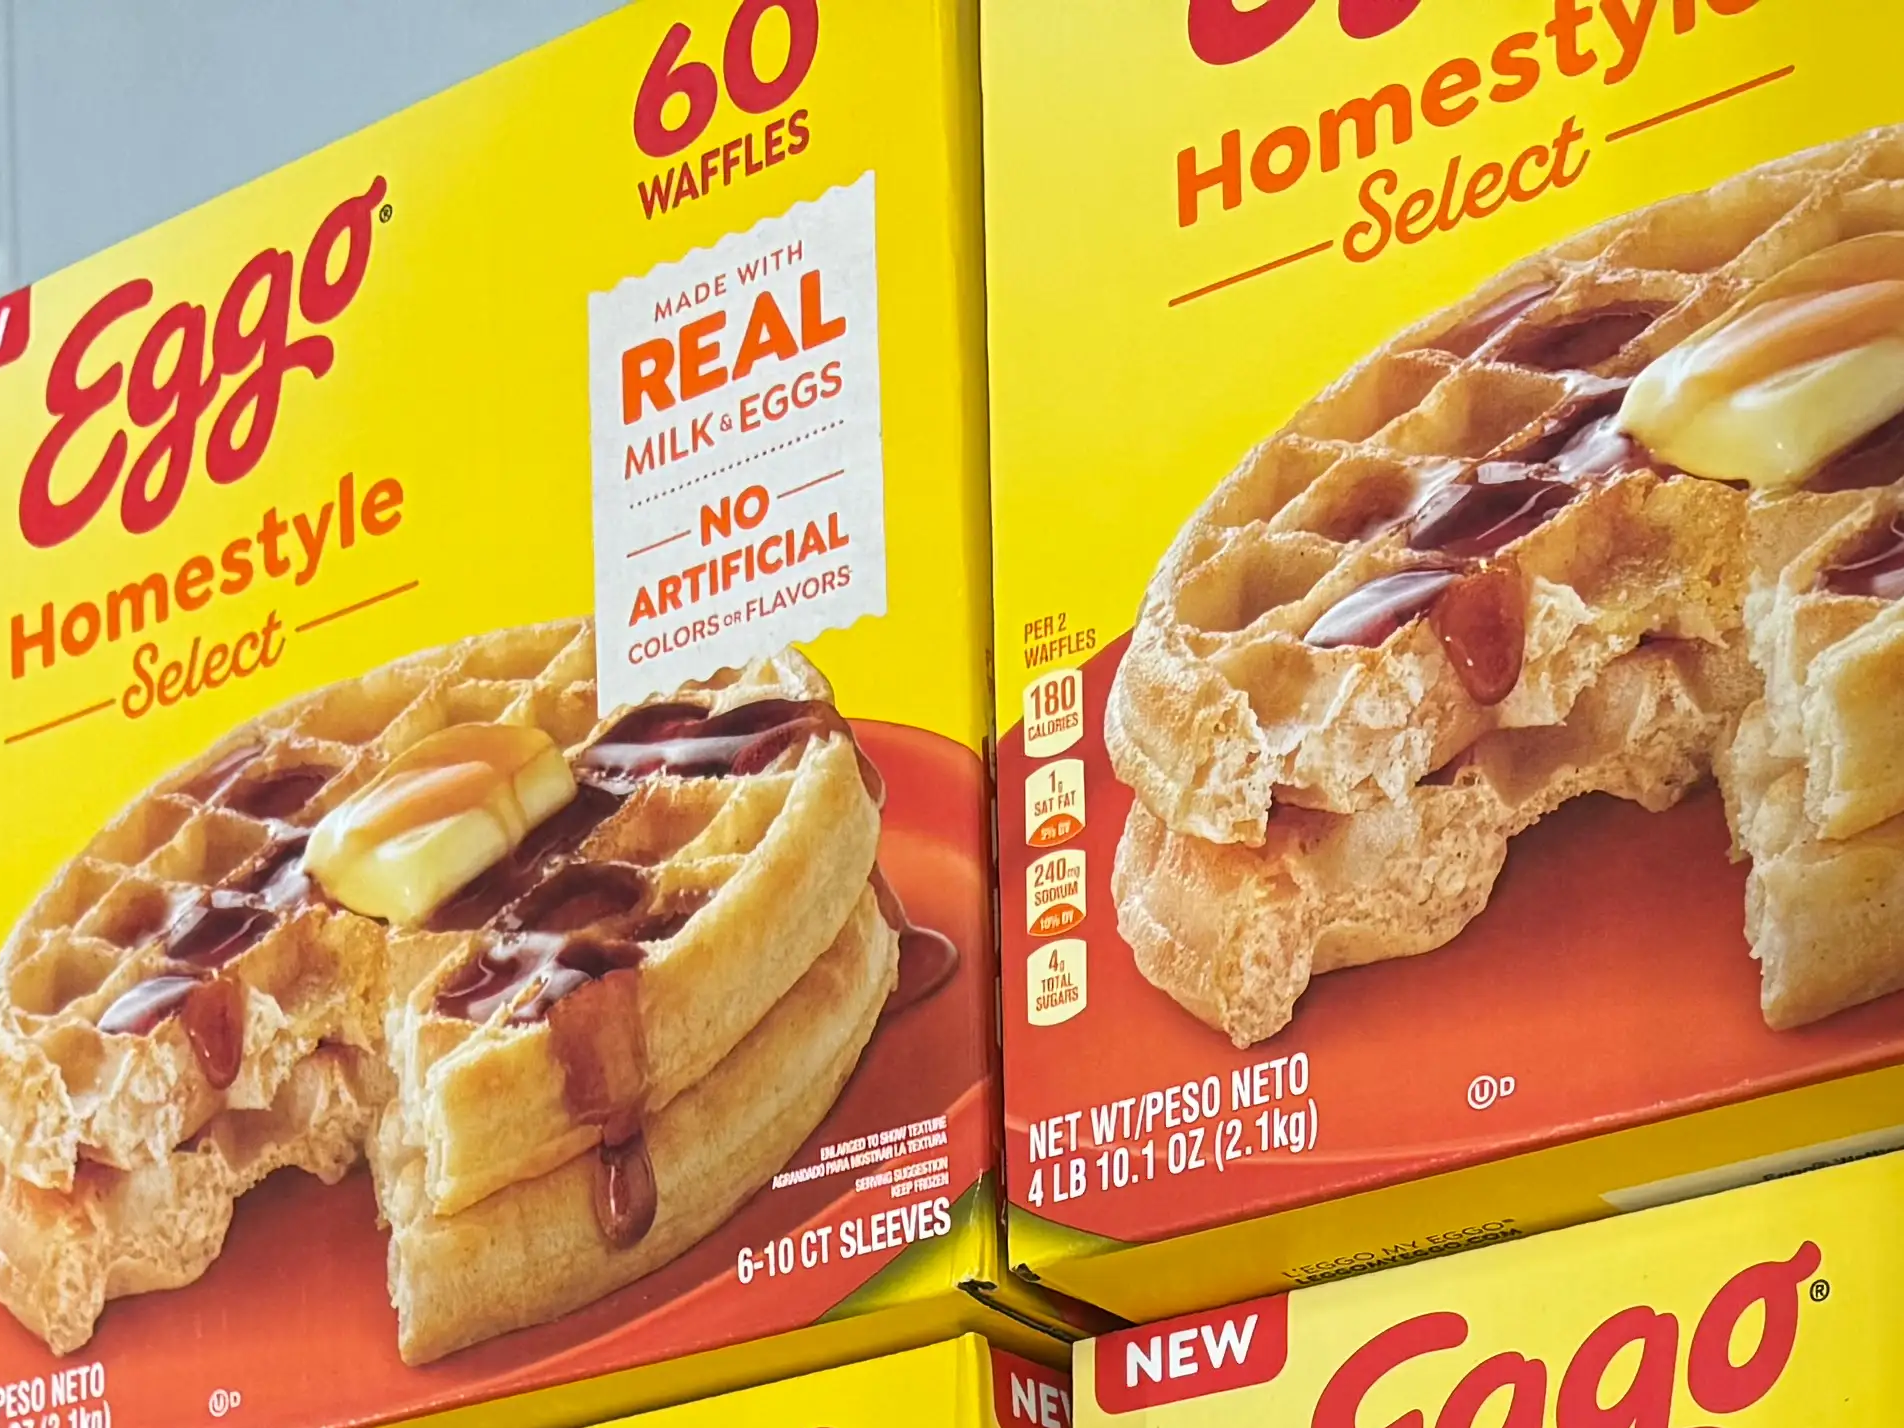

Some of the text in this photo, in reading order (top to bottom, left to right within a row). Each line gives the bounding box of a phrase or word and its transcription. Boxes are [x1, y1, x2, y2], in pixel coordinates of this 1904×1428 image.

[633, 0, 819, 157] 60
[1177, 0, 1761, 228] Homesty
[639, 110, 808, 218] WAFFLES
[1343, 115, 1590, 263] Select
[622, 270, 845, 424] REAL
[12, 471, 403, 679] Homestyle
[629, 514, 848, 625] ARTIFICIAL
[123, 609, 285, 718] Select
[1382, 1240, 1418, 1256] MY
[1127, 1315, 1257, 1386] NEW
